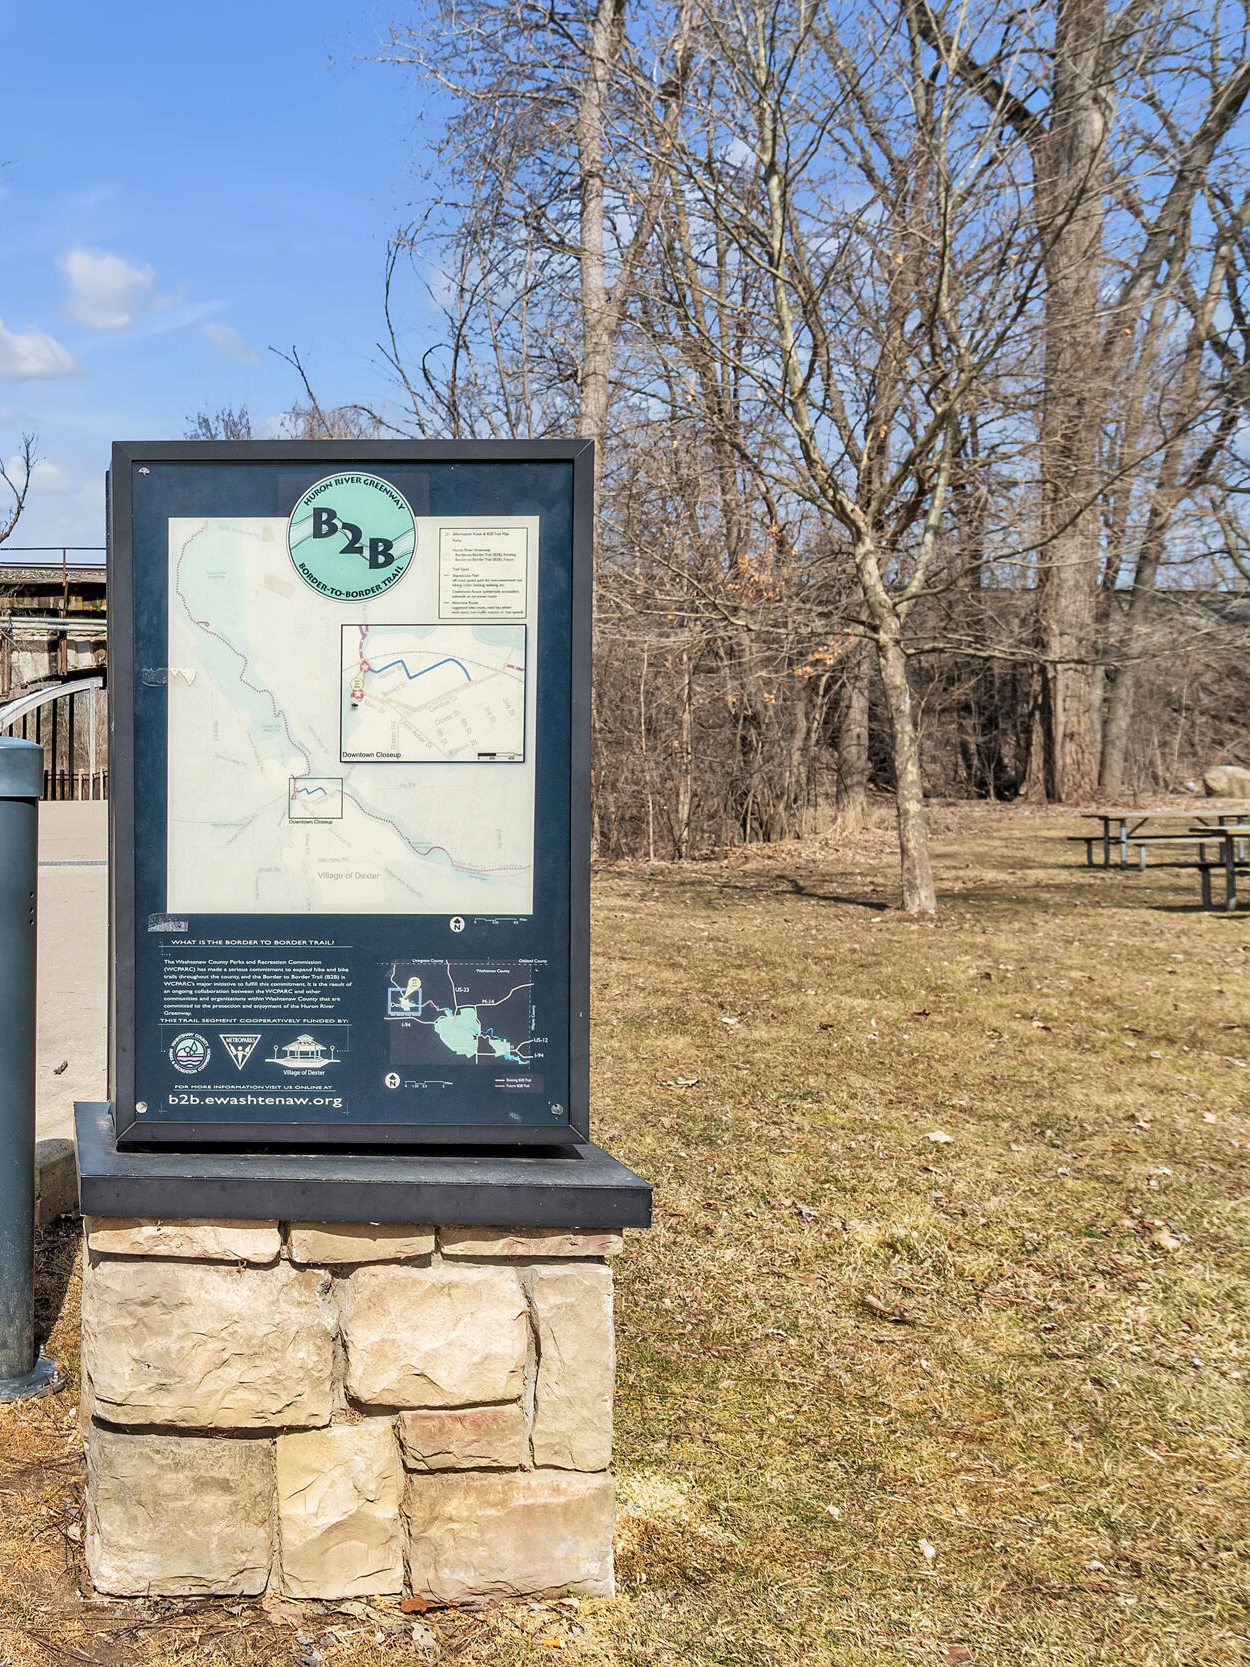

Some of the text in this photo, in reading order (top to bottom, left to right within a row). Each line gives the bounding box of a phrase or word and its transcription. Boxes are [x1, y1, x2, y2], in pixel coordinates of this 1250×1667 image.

[303, 477, 405, 510] HURON RIVER GREENWAY
[312, 507, 395, 569] B2B
[298, 562, 404, 598] BORDER-TO-BORDER TRAIL
[318, 872, 343, 881] Village
[168, 1094, 343, 1107] b2b.ewashtenaw.org
